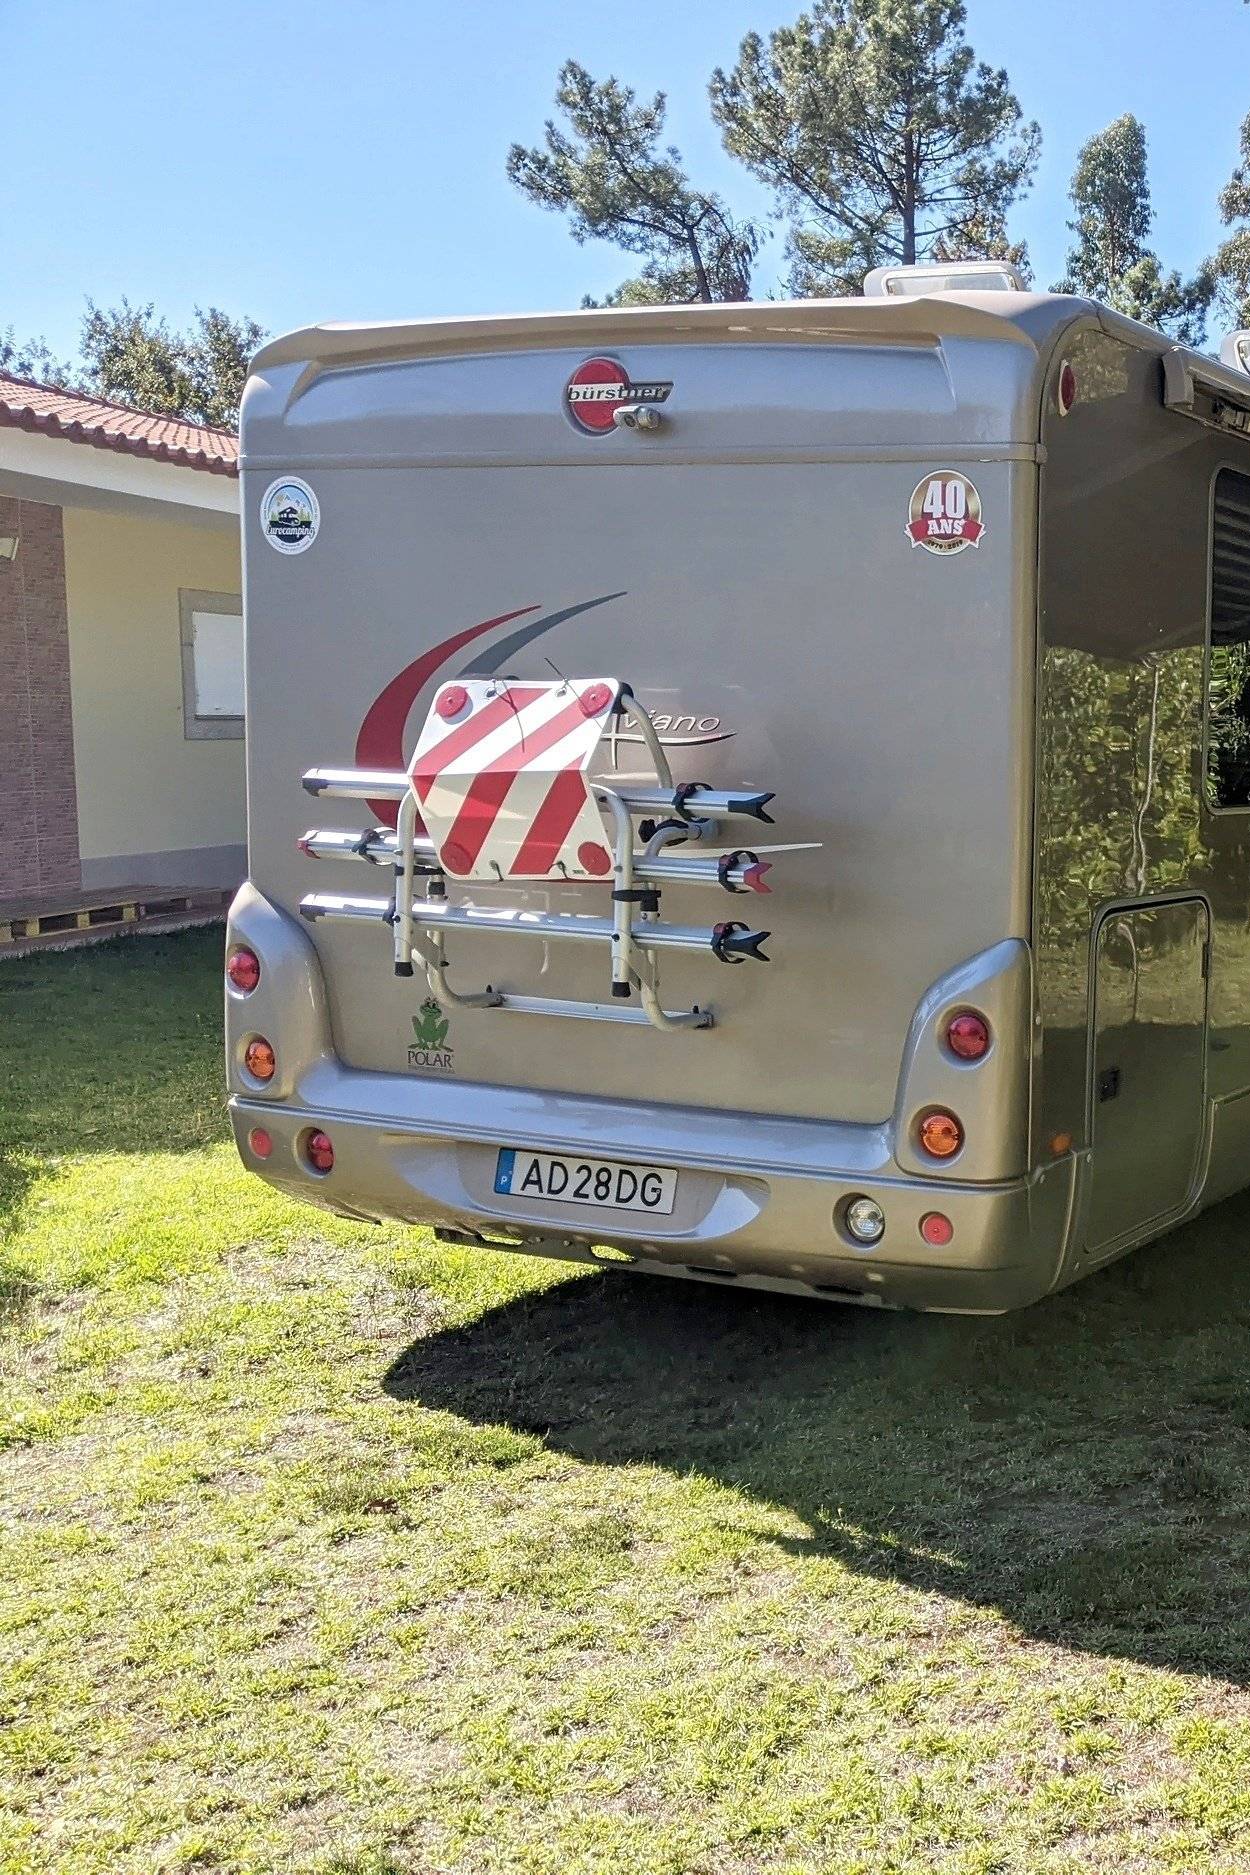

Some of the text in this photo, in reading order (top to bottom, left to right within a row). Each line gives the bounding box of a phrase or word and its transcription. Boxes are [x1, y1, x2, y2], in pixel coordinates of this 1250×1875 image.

[568, 386, 668, 402] bürstner
[923, 480, 966, 519] 40
[927, 519, 967, 535] ANS
[408, 1050, 453, 1068] POLAR
[520, 1158, 663, 1207] AD28DG
